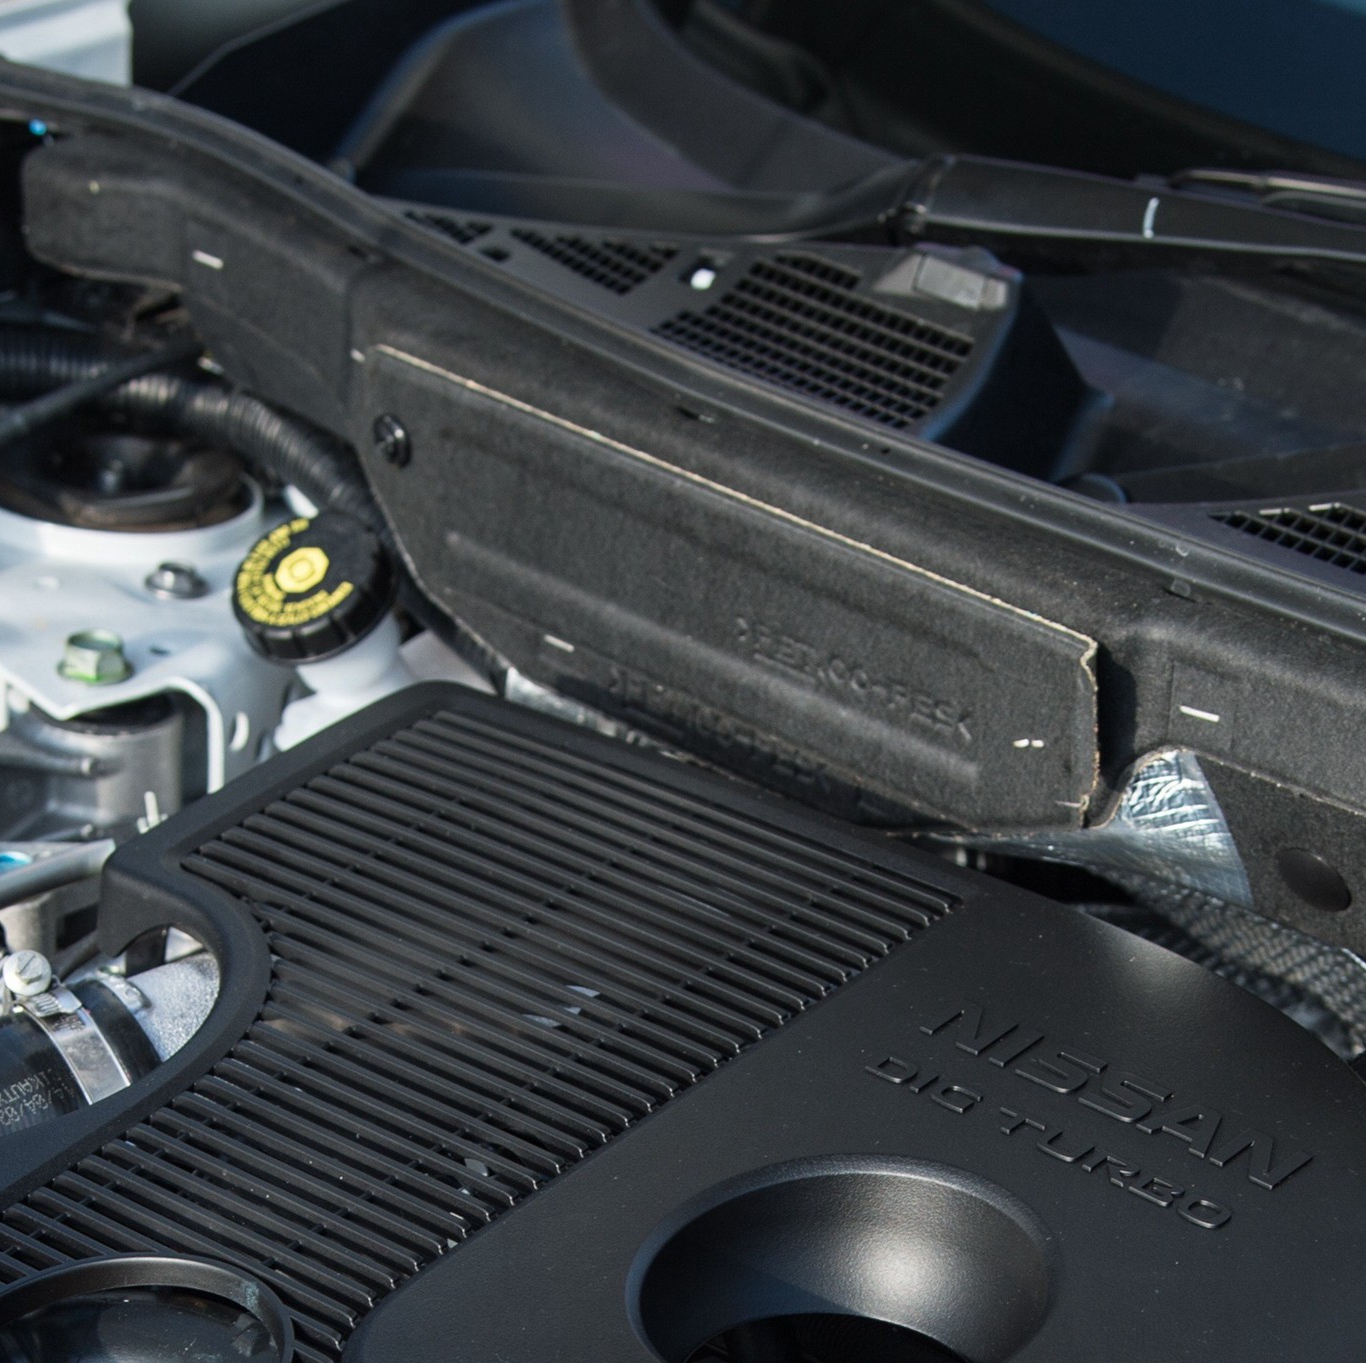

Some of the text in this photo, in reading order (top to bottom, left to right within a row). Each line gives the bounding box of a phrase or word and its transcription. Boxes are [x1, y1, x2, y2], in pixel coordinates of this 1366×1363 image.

[865, 1056, 1232, 1229] DIG TURBO
[919, 1002, 1313, 1190] NISSAN
